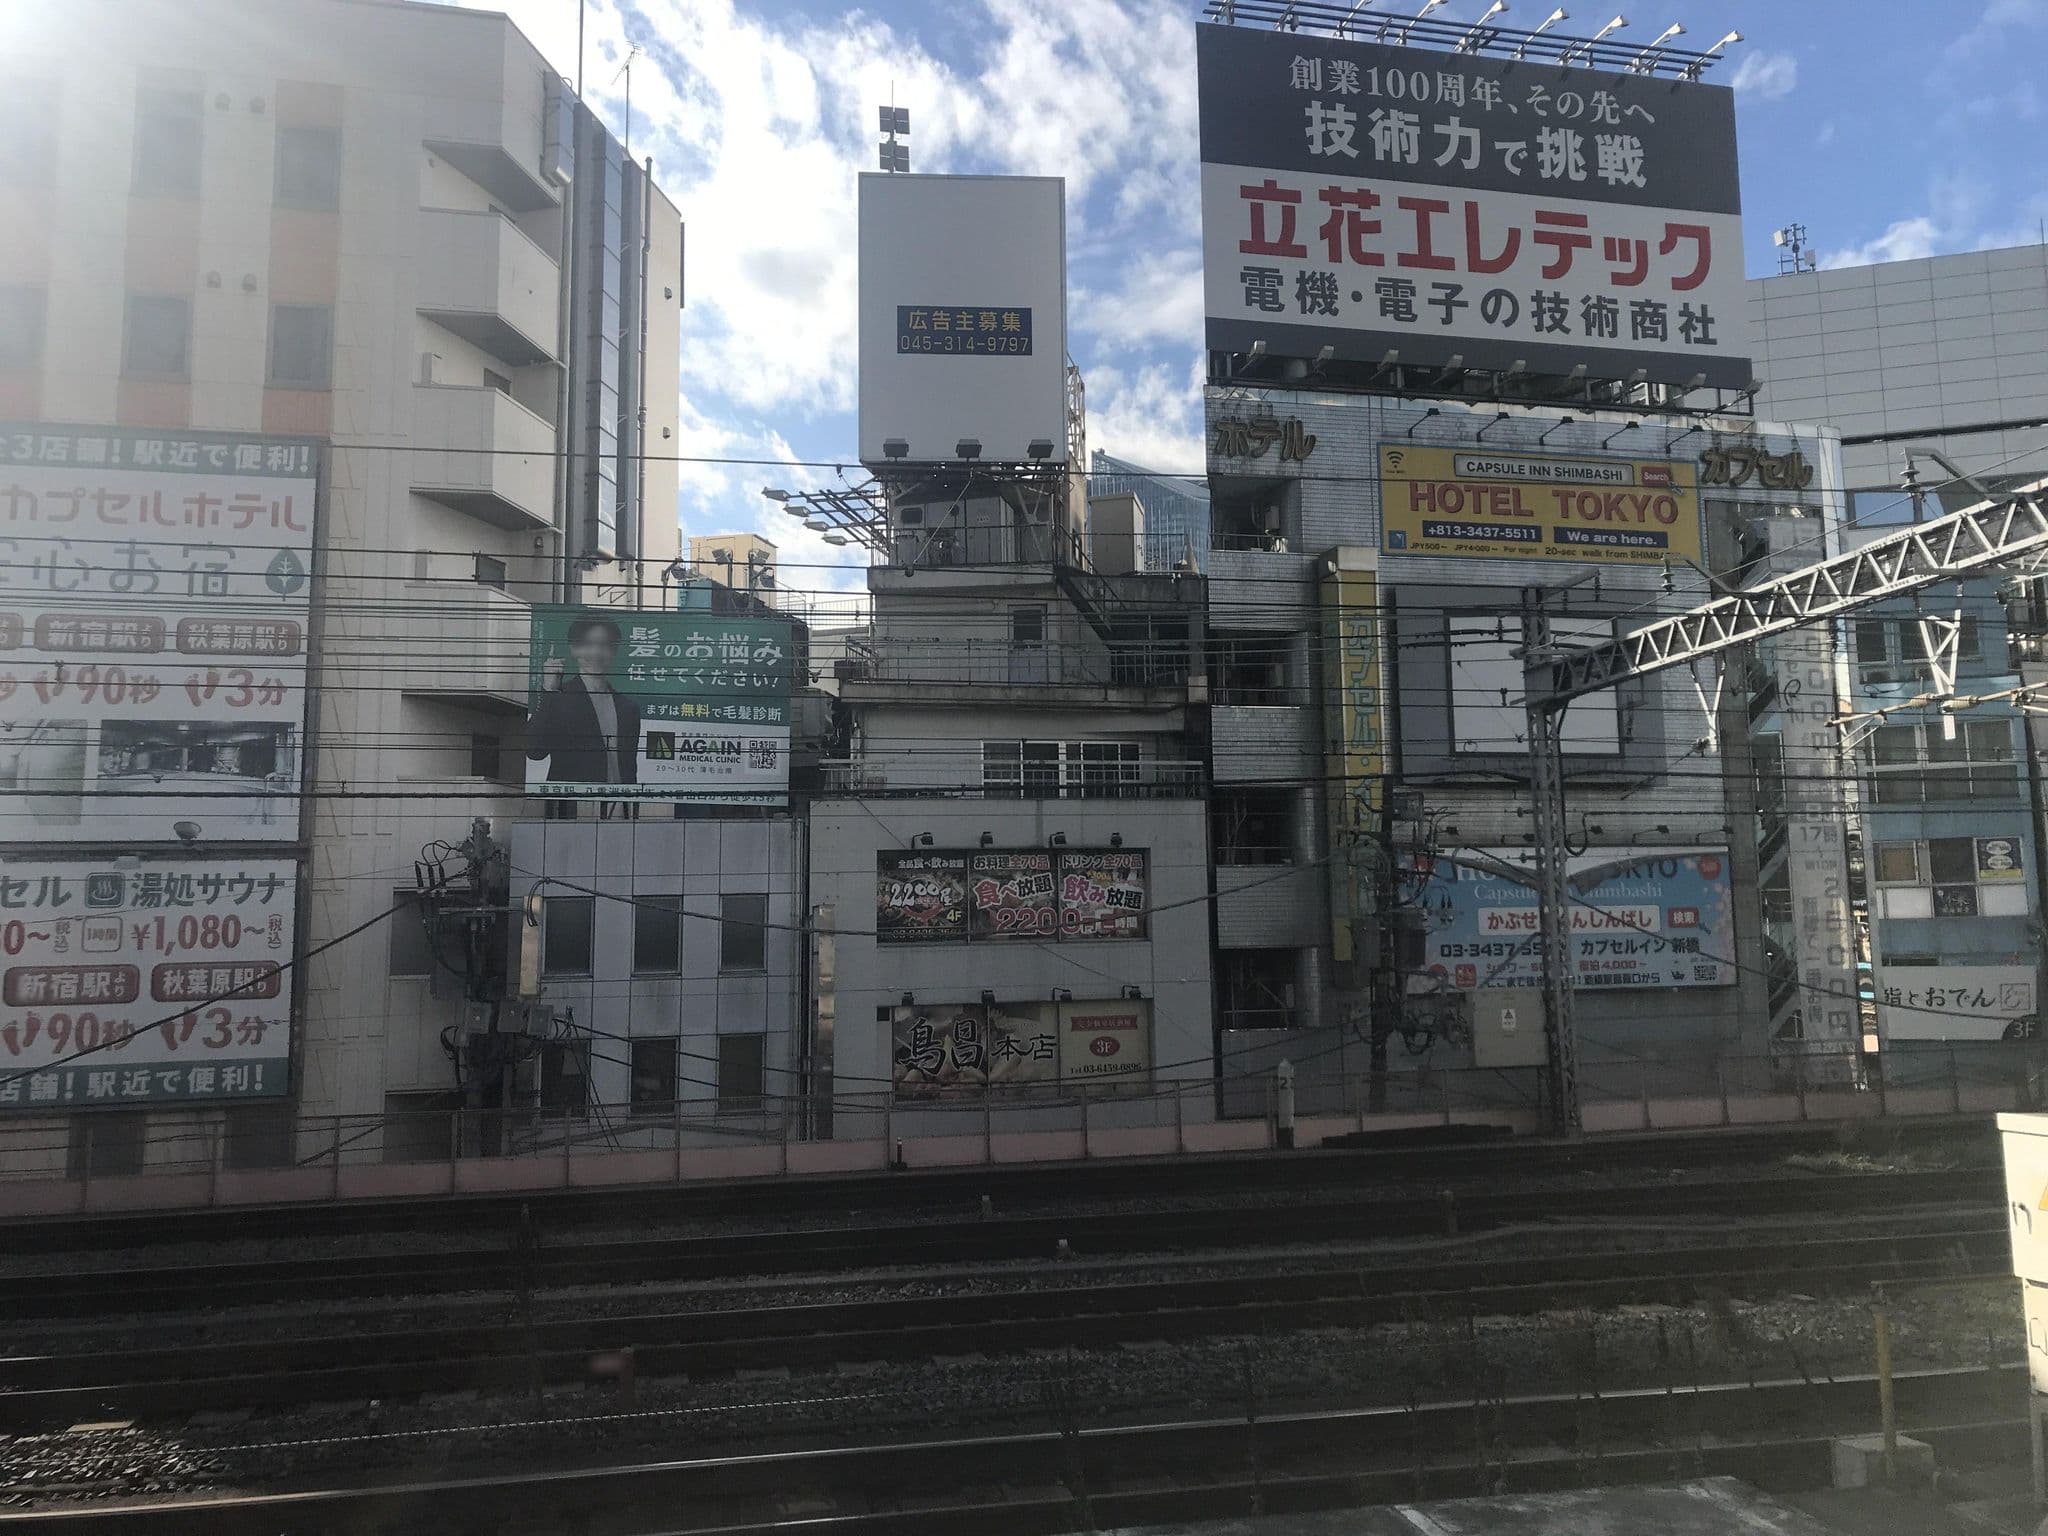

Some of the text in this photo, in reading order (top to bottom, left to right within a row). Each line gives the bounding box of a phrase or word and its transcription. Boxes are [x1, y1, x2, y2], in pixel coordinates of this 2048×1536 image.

[1288, 55, 1655, 125] 創業100周年、その先へ
[1304, 99, 1647, 188] 技術力で挑戦
[1239, 180, 1711, 291] 立花エレテック
[909, 310, 1021, 332] 広告主募集
[1239, 266, 1718, 346] 電機・電子の技術商社
[901, 335, 1029, 352] 045-314-9797
[1215, 416, 1316, 460] ホテル
[1466, 460, 1623, 481] CAPSULE INN SHIMBASHI
[0, 484, 306, 532] カプセルホテル
[1409, 481, 1678, 525] HOTEL TOKYO
[1428, 525, 1536, 540] +813-3437-5511
[1567, 530, 1657, 545] We are here.
[1605, 550, 1629, 558] from
[628, 627, 783, 666] 髪のお悩み
[225, 668, 288, 707] 3分
[646, 702, 782, 722] まずは無料で毛髪診断
[679, 754, 741, 764] MEDICAL CLINIC
[680, 739, 742, 756] AGAIN
[1061, 854, 1144, 869] ドリンク全70品
[131, 872, 286, 907] 湯処サウナ
[972, 873, 1053, 908] 食べ放題
[1063, 874, 1145, 910] 飲み放題
[946, 908, 962, 923] 4F
[19, 971, 127, 999] 新宿駅より
[162, 967, 270, 996] 秋葉原駅より
[47, 1011, 136, 1054] 90秒
[202, 1007, 268, 1049] 3分
[2013, 1021, 2035, 1038] 3F
